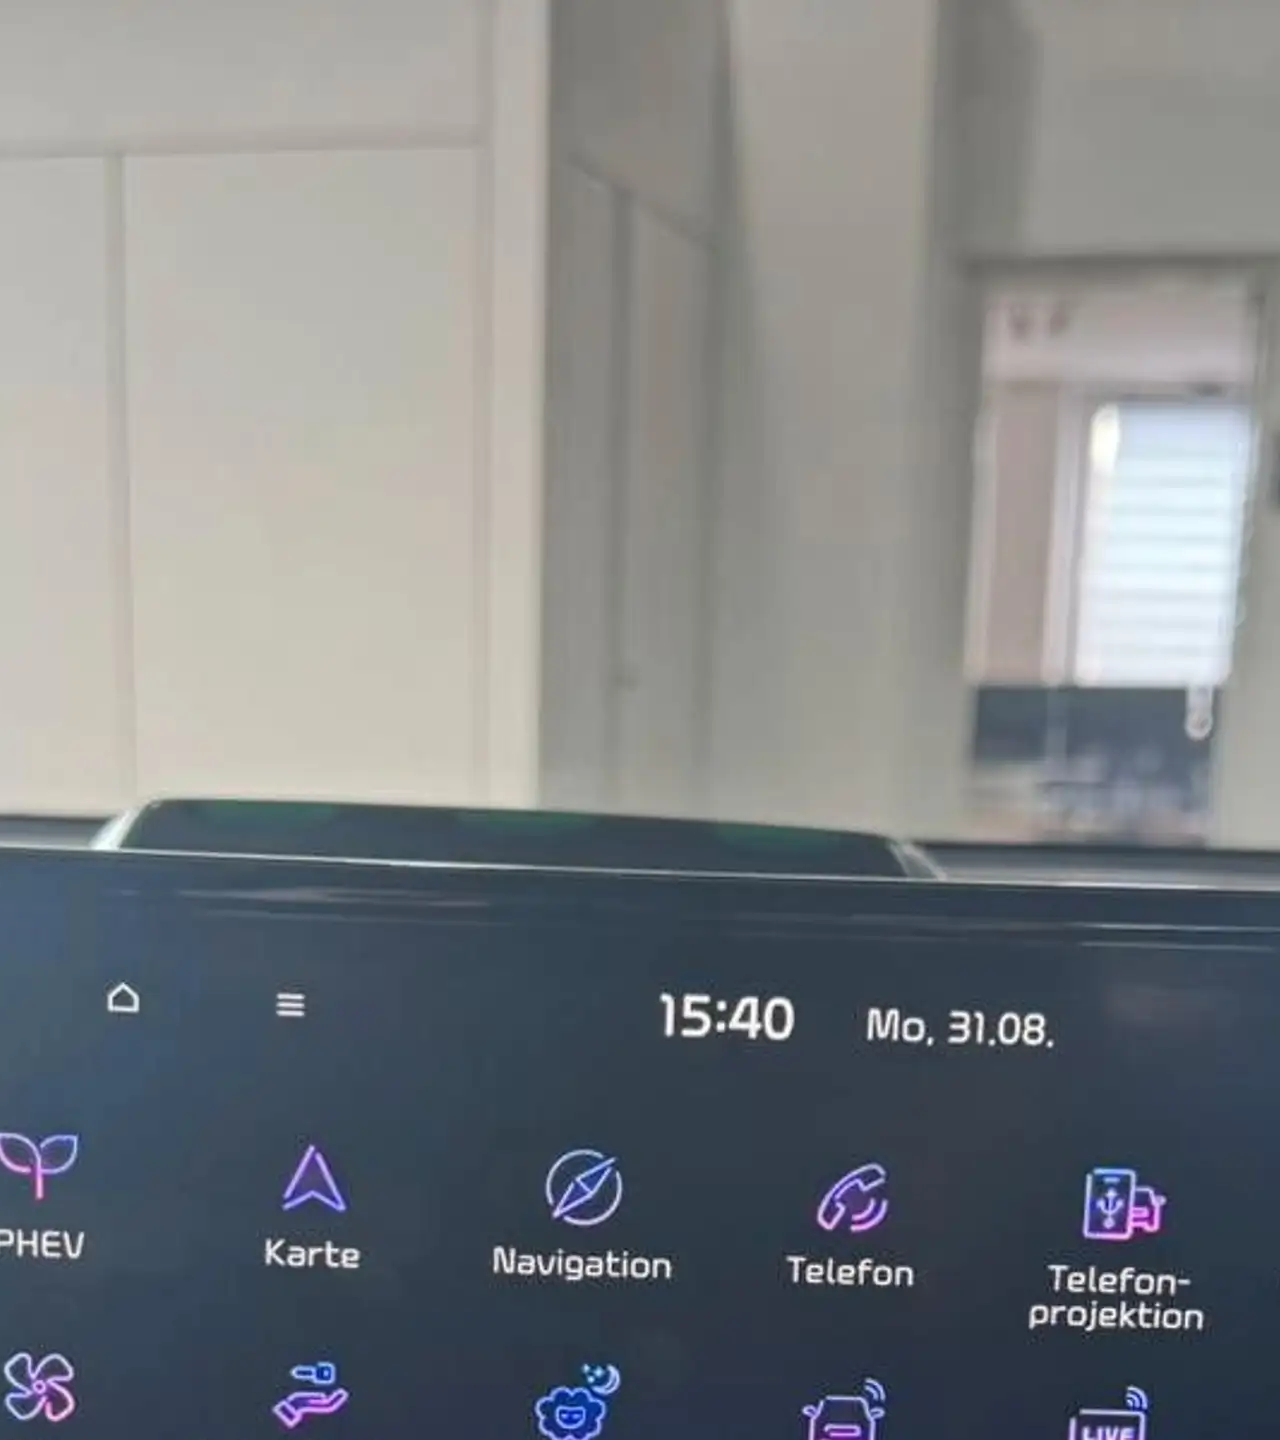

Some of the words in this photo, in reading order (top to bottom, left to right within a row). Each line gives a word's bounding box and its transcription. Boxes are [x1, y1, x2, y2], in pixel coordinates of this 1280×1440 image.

[659, 993, 795, 1041] 15:40
[948, 1010, 1054, 1048] 31.08.
[265, 1238, 360, 1269] Karte
[493, 1245, 672, 1281] Navigation
[786, 1255, 914, 1286] Telefon
[1047, 1264, 1191, 1296] Telefon-
[1028, 1300, 1204, 1332] projektion
